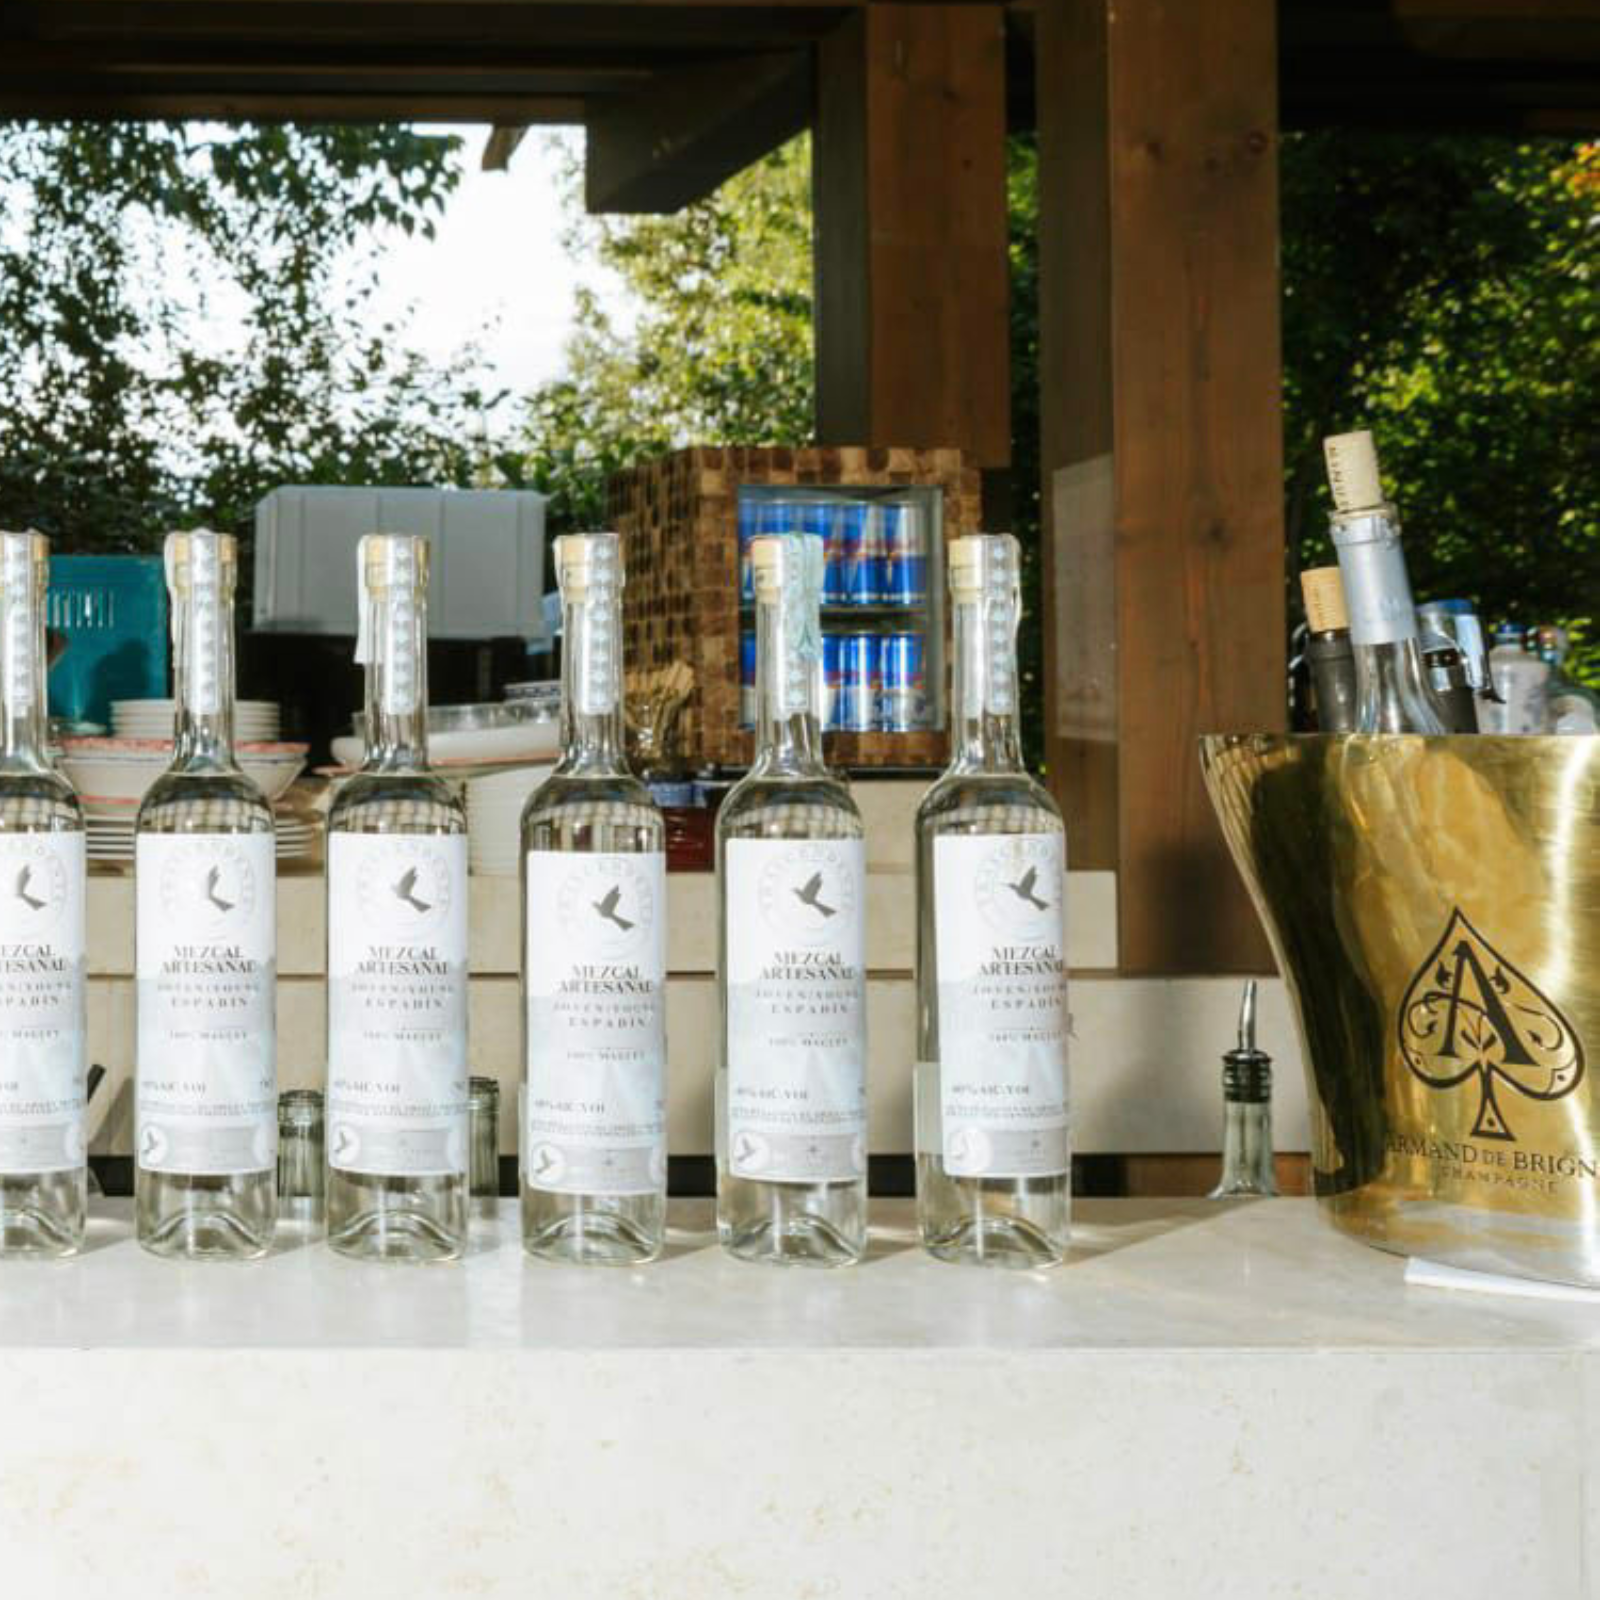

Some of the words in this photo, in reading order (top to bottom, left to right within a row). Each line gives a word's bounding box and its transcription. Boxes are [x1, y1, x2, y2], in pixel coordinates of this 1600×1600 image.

[174, 944, 244, 959] MEZCAL
[368, 945, 438, 960] MEZCAL
[774, 950, 844, 966] MEZCAL
[161, 959, 257, 975] ARTESANAL
[357, 959, 450, 976] ARTESANAL
[572, 965, 641, 980] MEZCAL
[760, 966, 857, 980] ARTESANAL
[979, 958, 1064, 976] ARTESANA
[558, 979, 654, 995] ARTESANAL
[1386, 1133, 1477, 1163] ARMAND
[1482, 1149, 1507, 1167] DE
[1440, 1166, 1558, 1195] CHAMPAGNE
